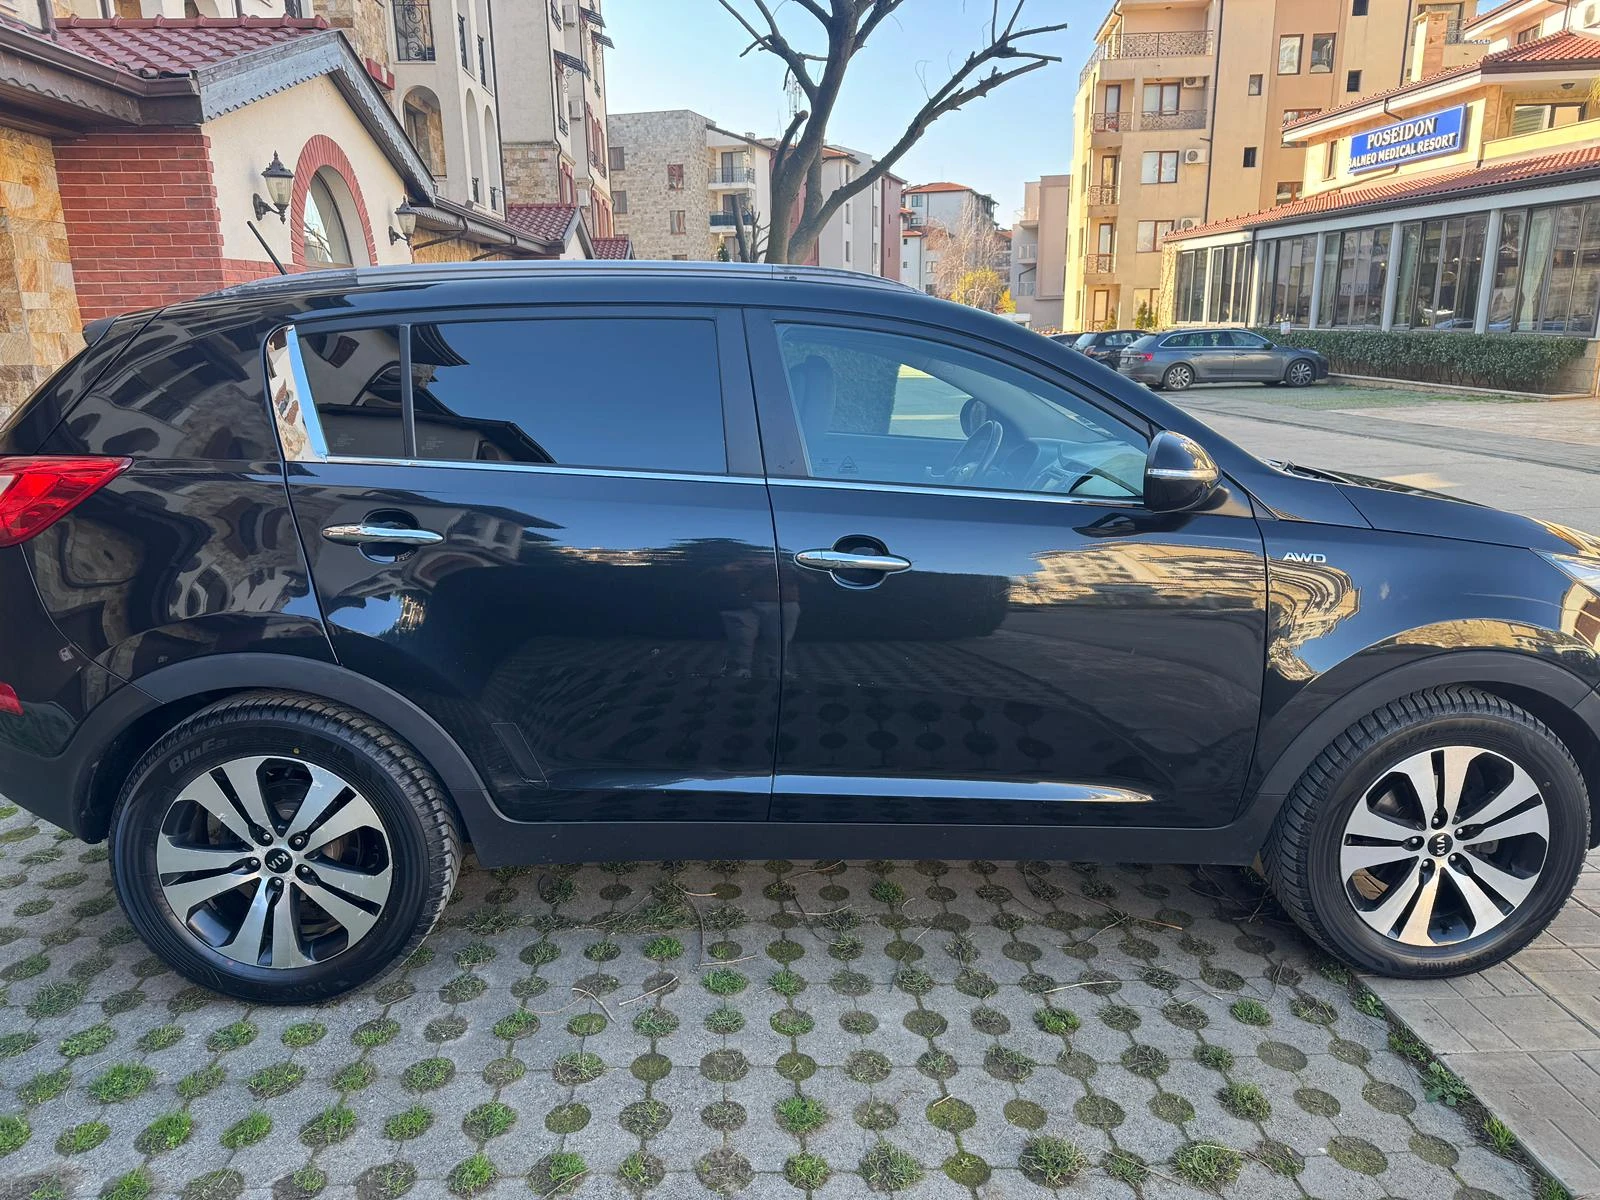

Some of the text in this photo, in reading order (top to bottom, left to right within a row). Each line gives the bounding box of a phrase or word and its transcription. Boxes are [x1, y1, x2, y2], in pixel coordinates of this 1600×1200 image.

[1367, 117, 1436, 149] POSEIDON
[1377, 143, 1416, 161] MEDICAL
[1418, 133, 1456, 153] RESORT
[1282, 552, 1327, 563] AWD
[1437, 835, 1445, 855] KIA
[268, 852, 289, 869] KIA
